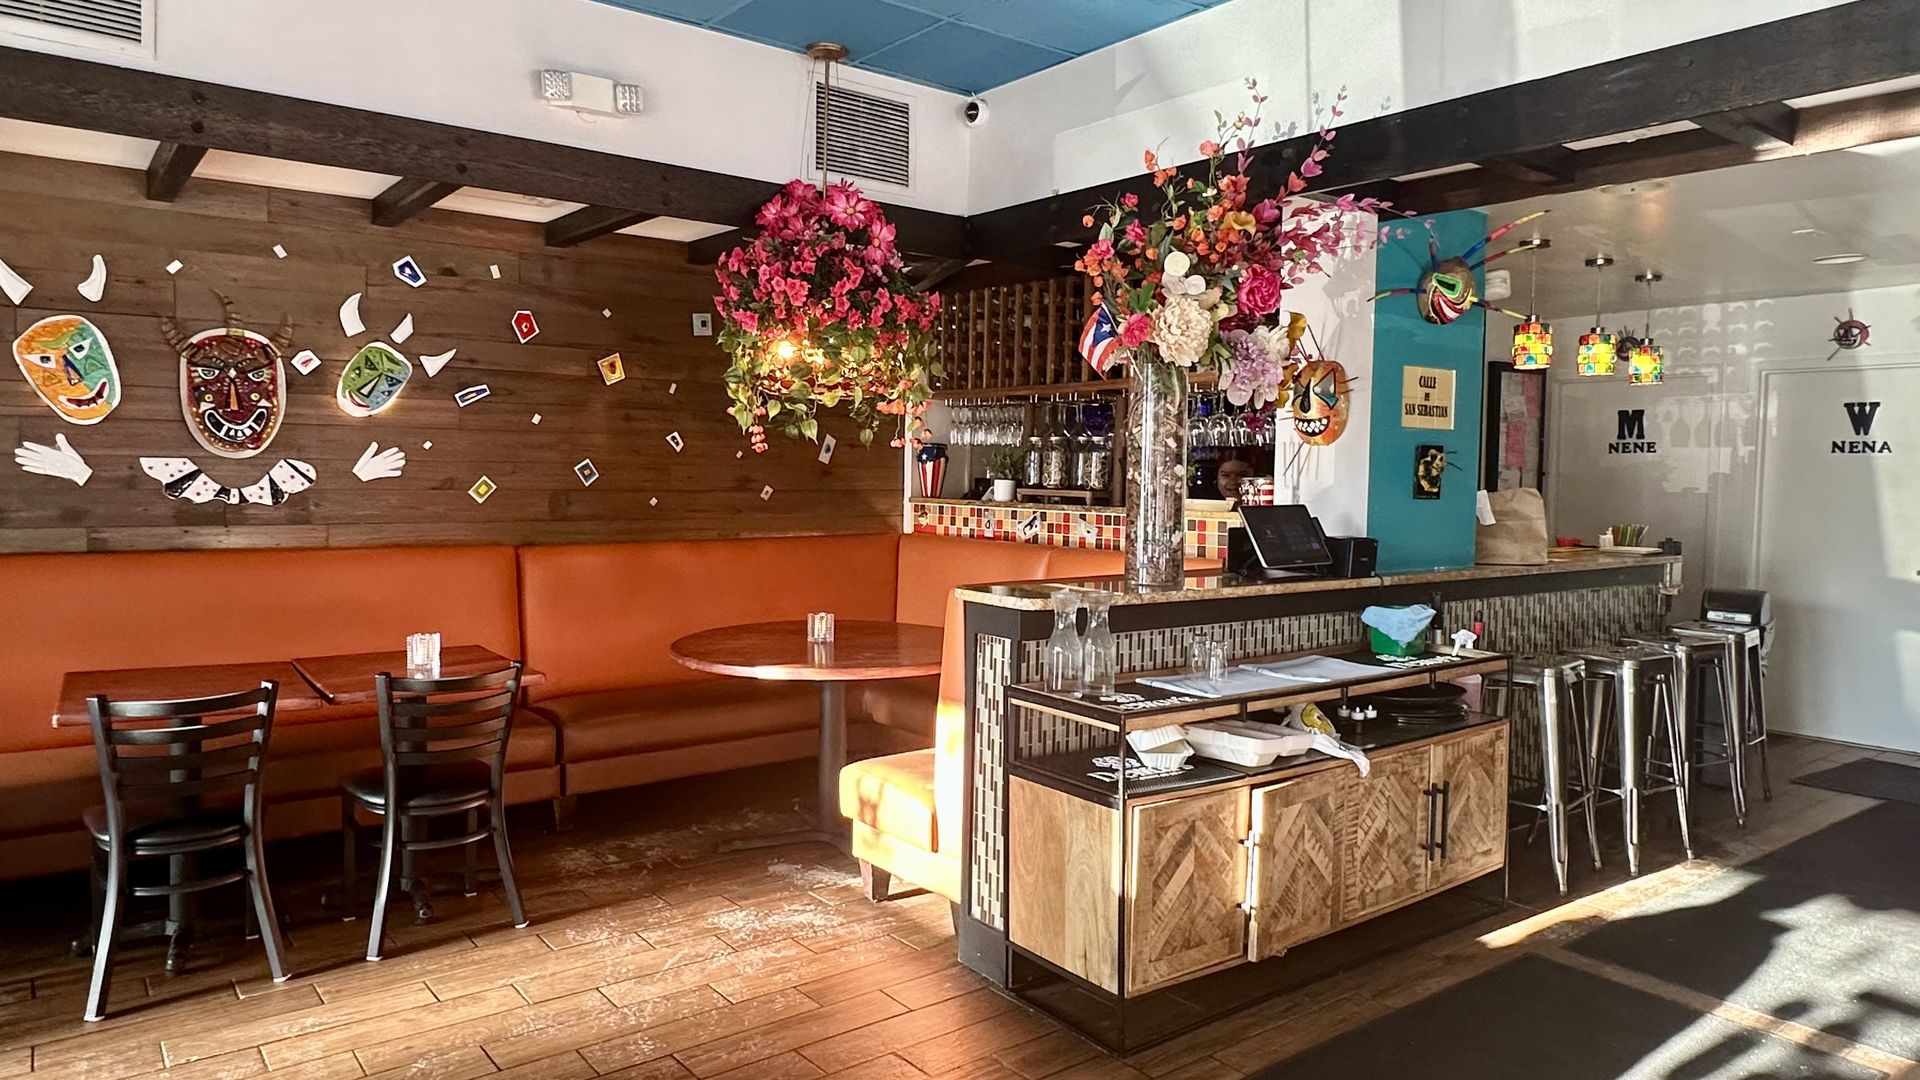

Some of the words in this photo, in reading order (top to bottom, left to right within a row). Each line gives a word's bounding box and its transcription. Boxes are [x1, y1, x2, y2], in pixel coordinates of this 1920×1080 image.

[1419, 375, 1437, 389] CALLE
[1404, 402, 1416, 415] SAN
[1417, 404, 1448, 417] SEBASTIAN
[1617, 409, 1645, 440] M
[1843, 401, 1880, 436] W
[1608, 441, 1656, 454] NENE
[1831, 440, 1892, 453] NENA
